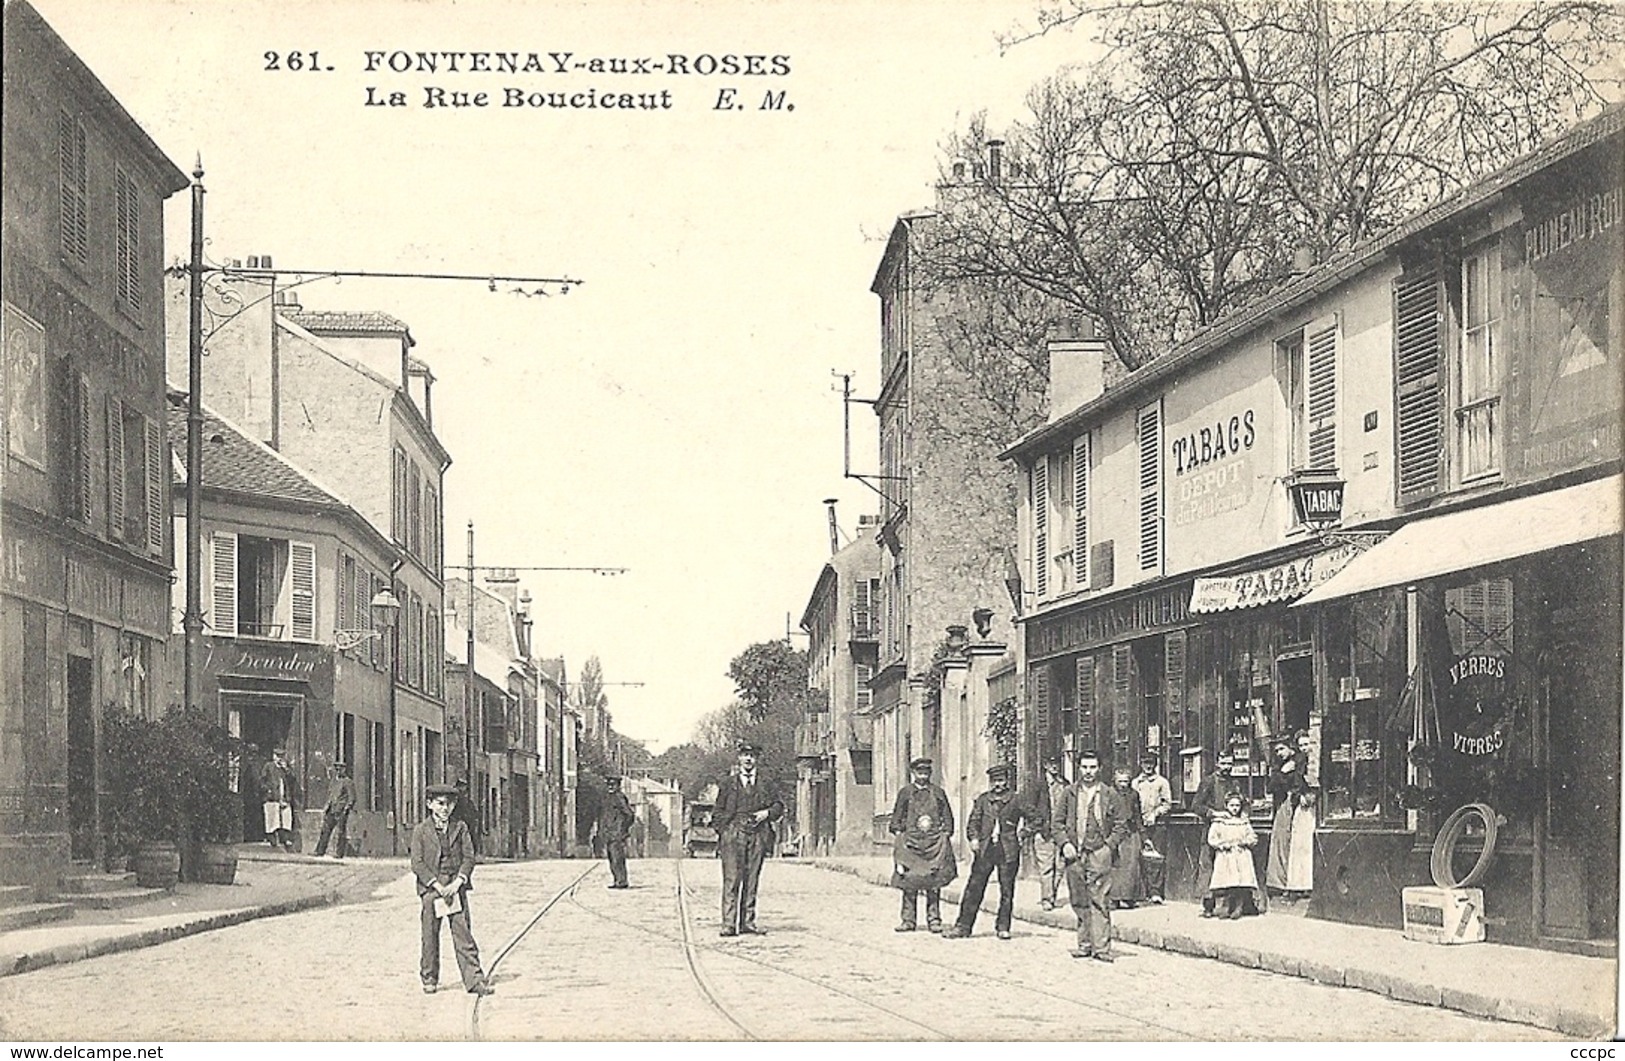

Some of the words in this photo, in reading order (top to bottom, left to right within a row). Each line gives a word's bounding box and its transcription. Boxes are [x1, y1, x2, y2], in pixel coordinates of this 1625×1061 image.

[1172, 409, 1255, 476] TABACS
[1305, 489, 1341, 512] TABAC
[1235, 557, 1313, 603] TABAC
[1449, 656, 1505, 685] VERRES
[1453, 730, 1503, 755] VITRES
